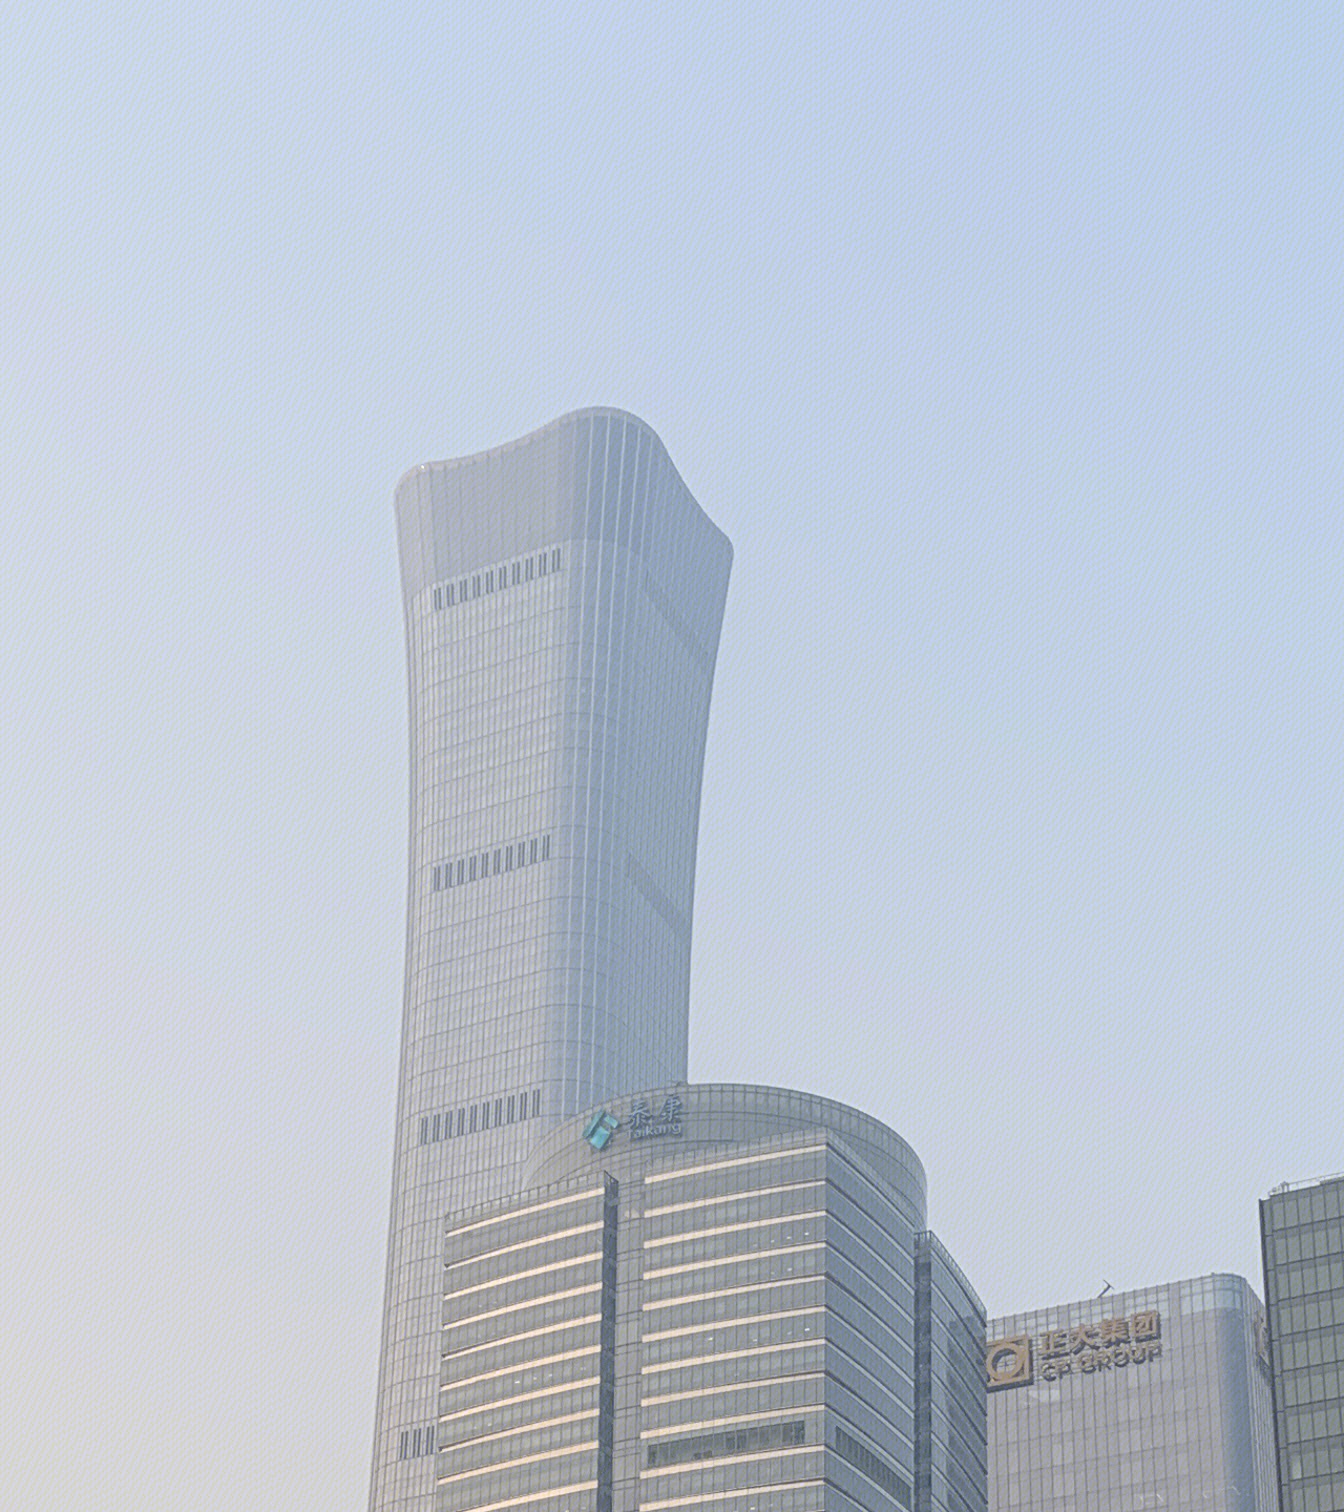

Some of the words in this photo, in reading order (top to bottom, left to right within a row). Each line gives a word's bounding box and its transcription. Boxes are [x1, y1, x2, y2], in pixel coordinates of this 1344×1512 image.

[629, 1093, 682, 1129] 泰康
[627, 1123, 682, 1138] Taikang
[1038, 1311, 1161, 1358] 正大集团
[1039, 1359, 1072, 1382] CP
[1078, 1341, 1162, 1375] GROUP
